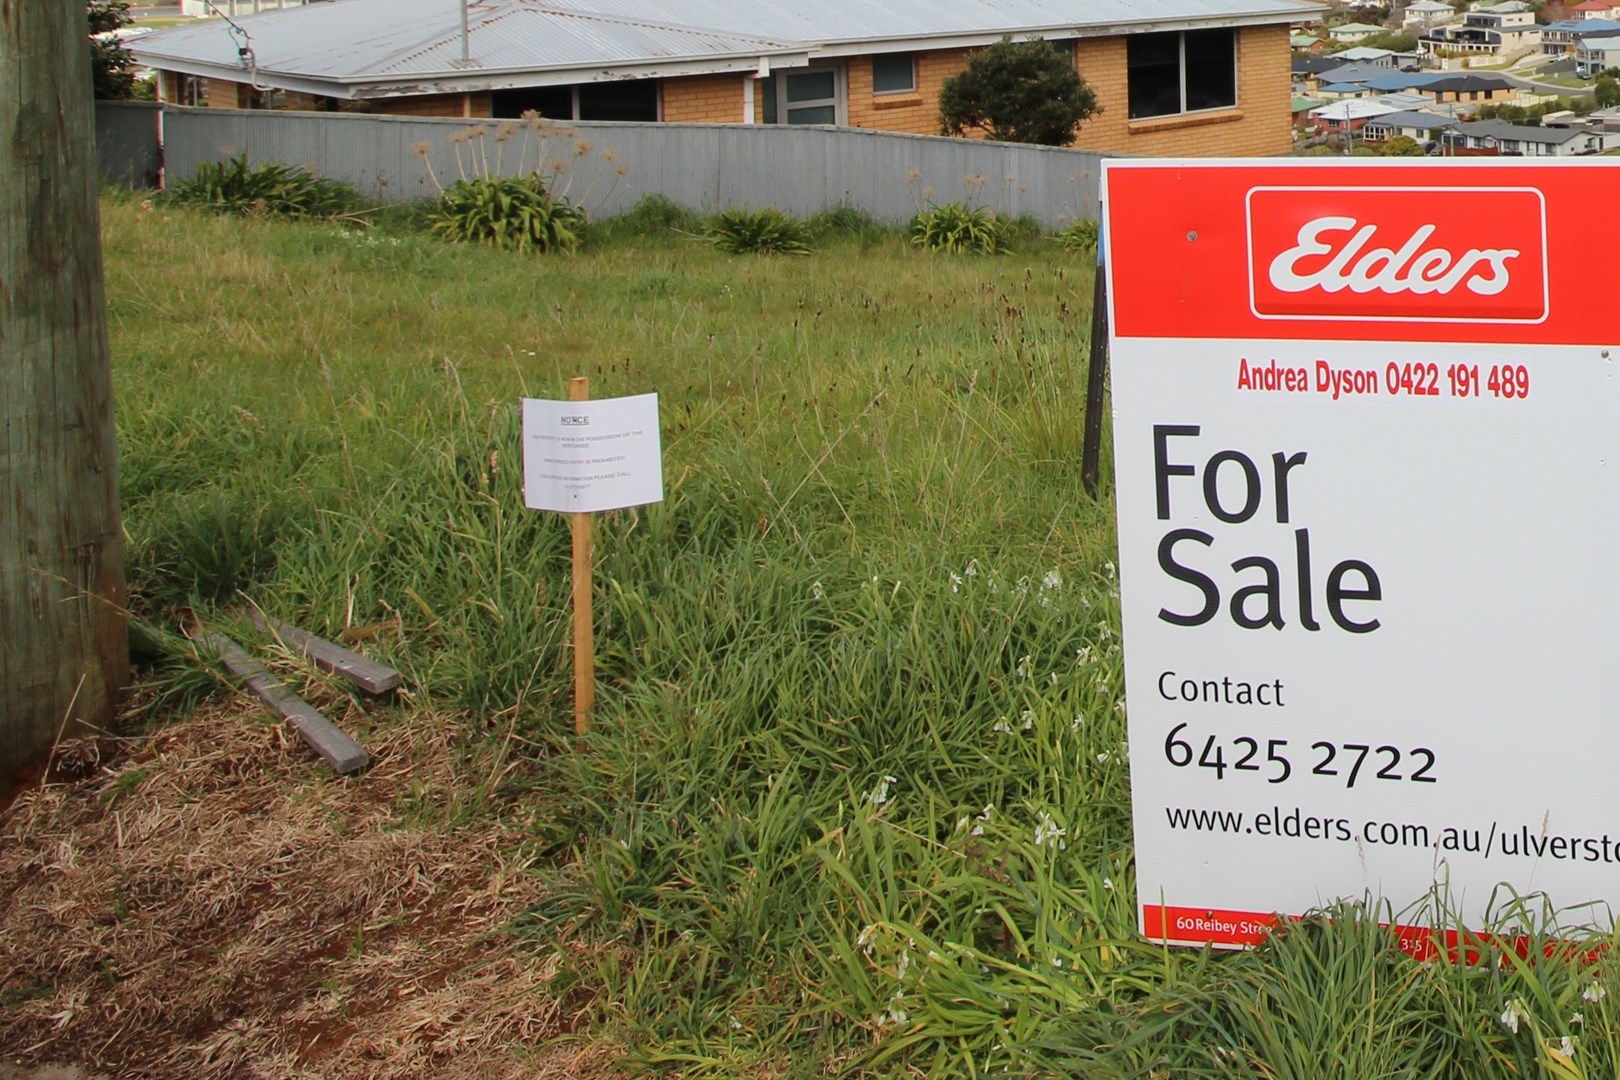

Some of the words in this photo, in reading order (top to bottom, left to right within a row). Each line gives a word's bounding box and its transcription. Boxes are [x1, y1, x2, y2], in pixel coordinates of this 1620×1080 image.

[1268, 216, 1520, 296] Elders
[1237, 358, 1308, 392] Andrea
[1315, 360, 1378, 400] Dyson
[1385, 361, 1440, 397] 0422
[1447, 363, 1480, 397] 191
[1487, 364, 1530, 399] 489
[1152, 424, 1308, 524] For
[1157, 528, 1383, 634] Sale
[1158, 671, 1285, 707] Contact
[1164, 722, 1292, 784] 6425
[1310, 741, 1437, 789] 2722
[1176, 917, 1194, 930] 60
[1195, 918, 1237, 935] Reibey
